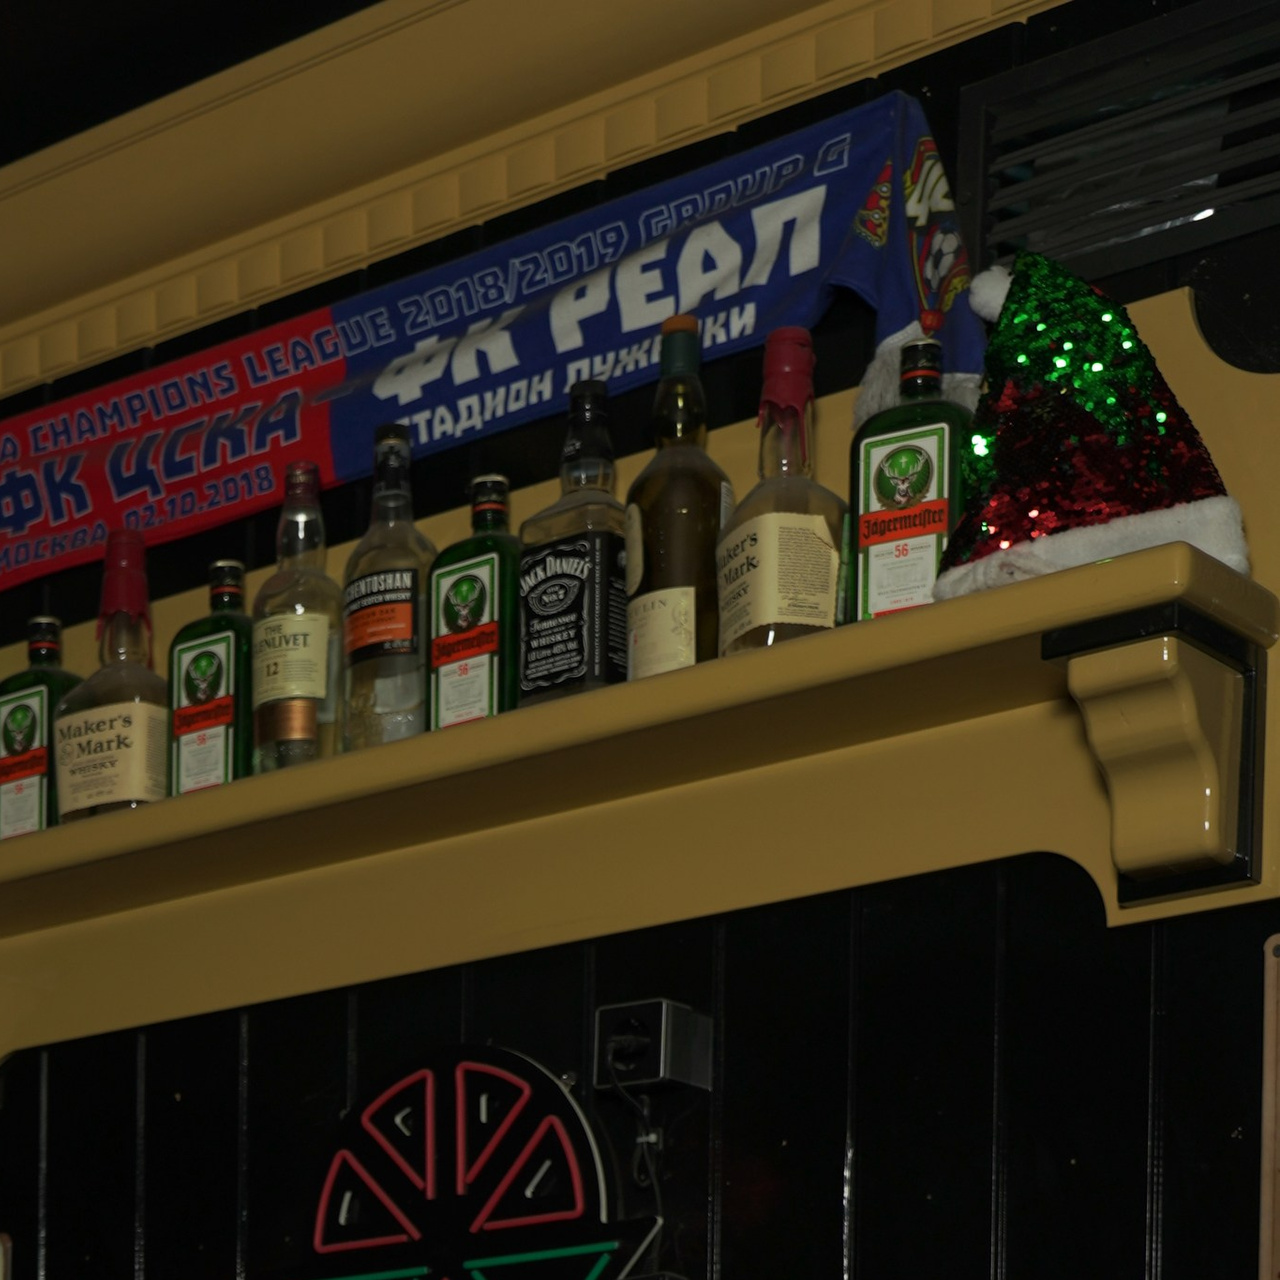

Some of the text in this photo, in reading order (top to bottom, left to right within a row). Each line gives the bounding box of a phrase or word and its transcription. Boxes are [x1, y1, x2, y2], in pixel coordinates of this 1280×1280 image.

[28, 360, 238, 456] CHAMPIONS
[243, 308, 396, 389] LEAGUE
[403, 222, 630, 336] 2018/2019
[638, 154, 804, 243] GROUP
[813, 132, 851, 177] G
[372, 184, 828, 406] ФК РЕАЛ
[563, 302, 757, 394] ЛУЖКИ
[106, 388, 303, 503] ЦСКА
[123, 464, 276, 531] 02.10.2018
[863, 507, 945, 540] Jägermeister
[894, 543, 909, 558] 56
[520, 563, 547, 597] JACK
[266, 662, 279, 677] 12
[58, 713, 133, 745] Maker's
[75, 734, 132, 759] Mark
